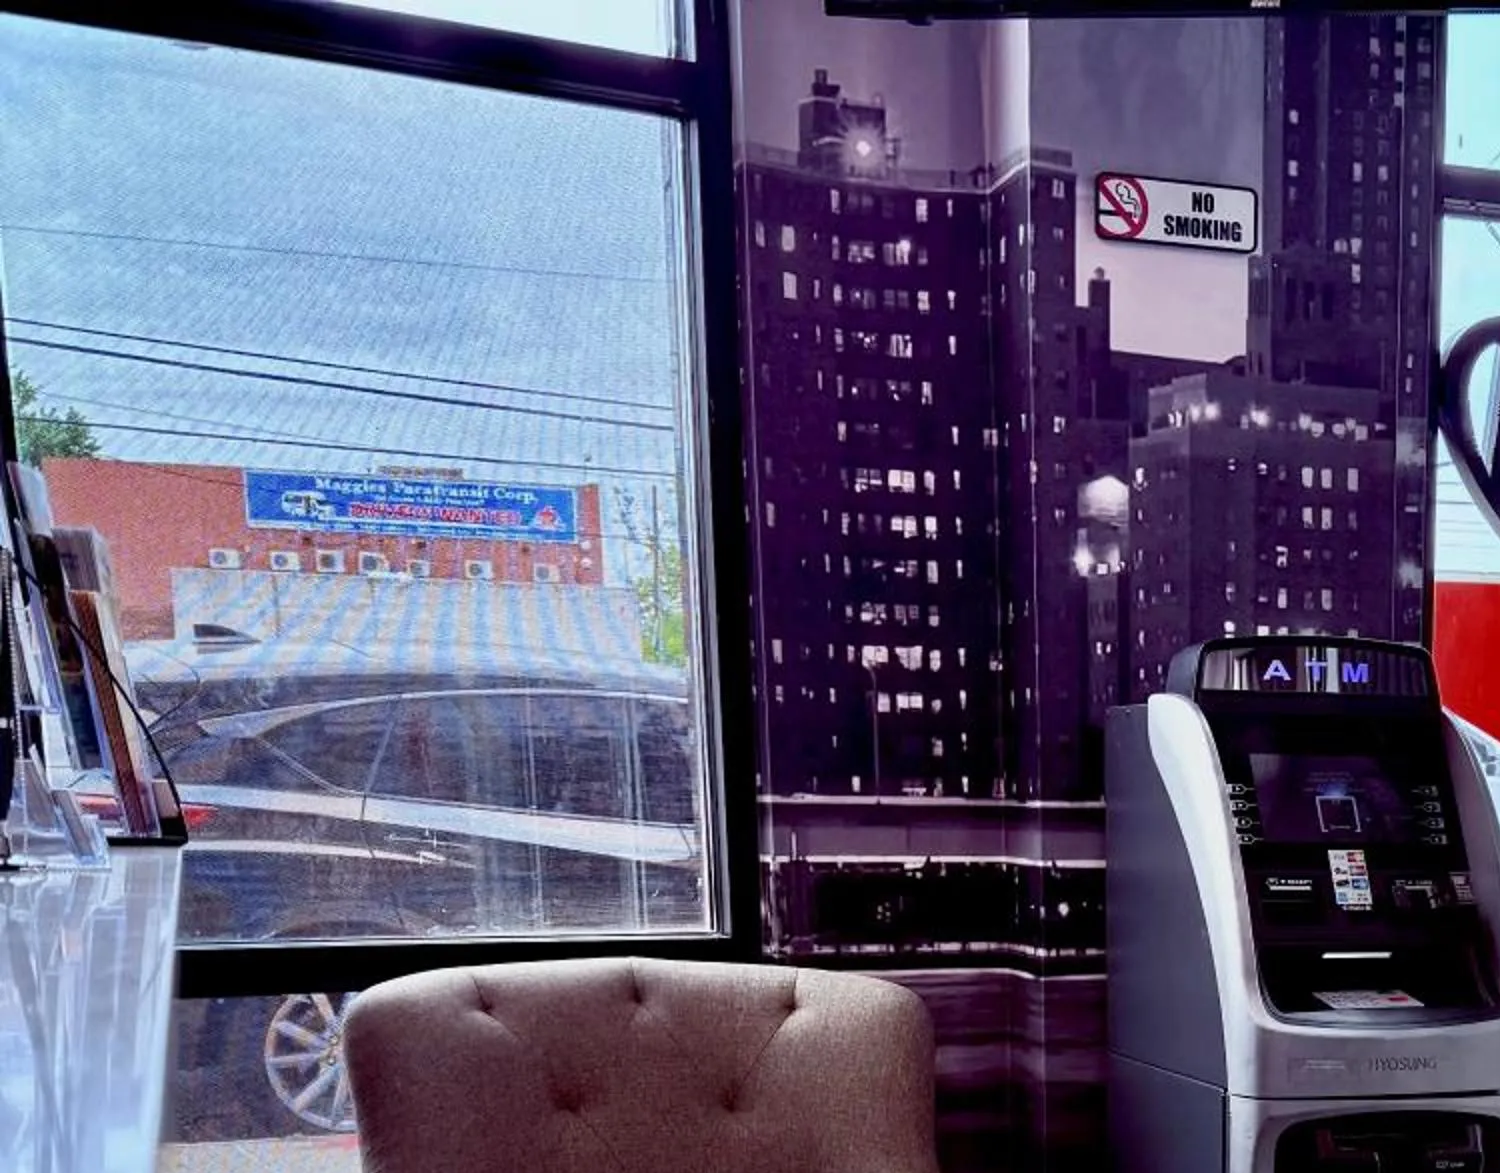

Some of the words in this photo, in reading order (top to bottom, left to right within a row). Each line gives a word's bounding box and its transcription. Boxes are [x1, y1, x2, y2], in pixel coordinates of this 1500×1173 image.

[1191, 191, 1215, 213] NO
[1163, 215, 1243, 243] SMOKING
[392, 480, 489, 499] Paratransit
[1262, 658, 1370, 684] ATM
